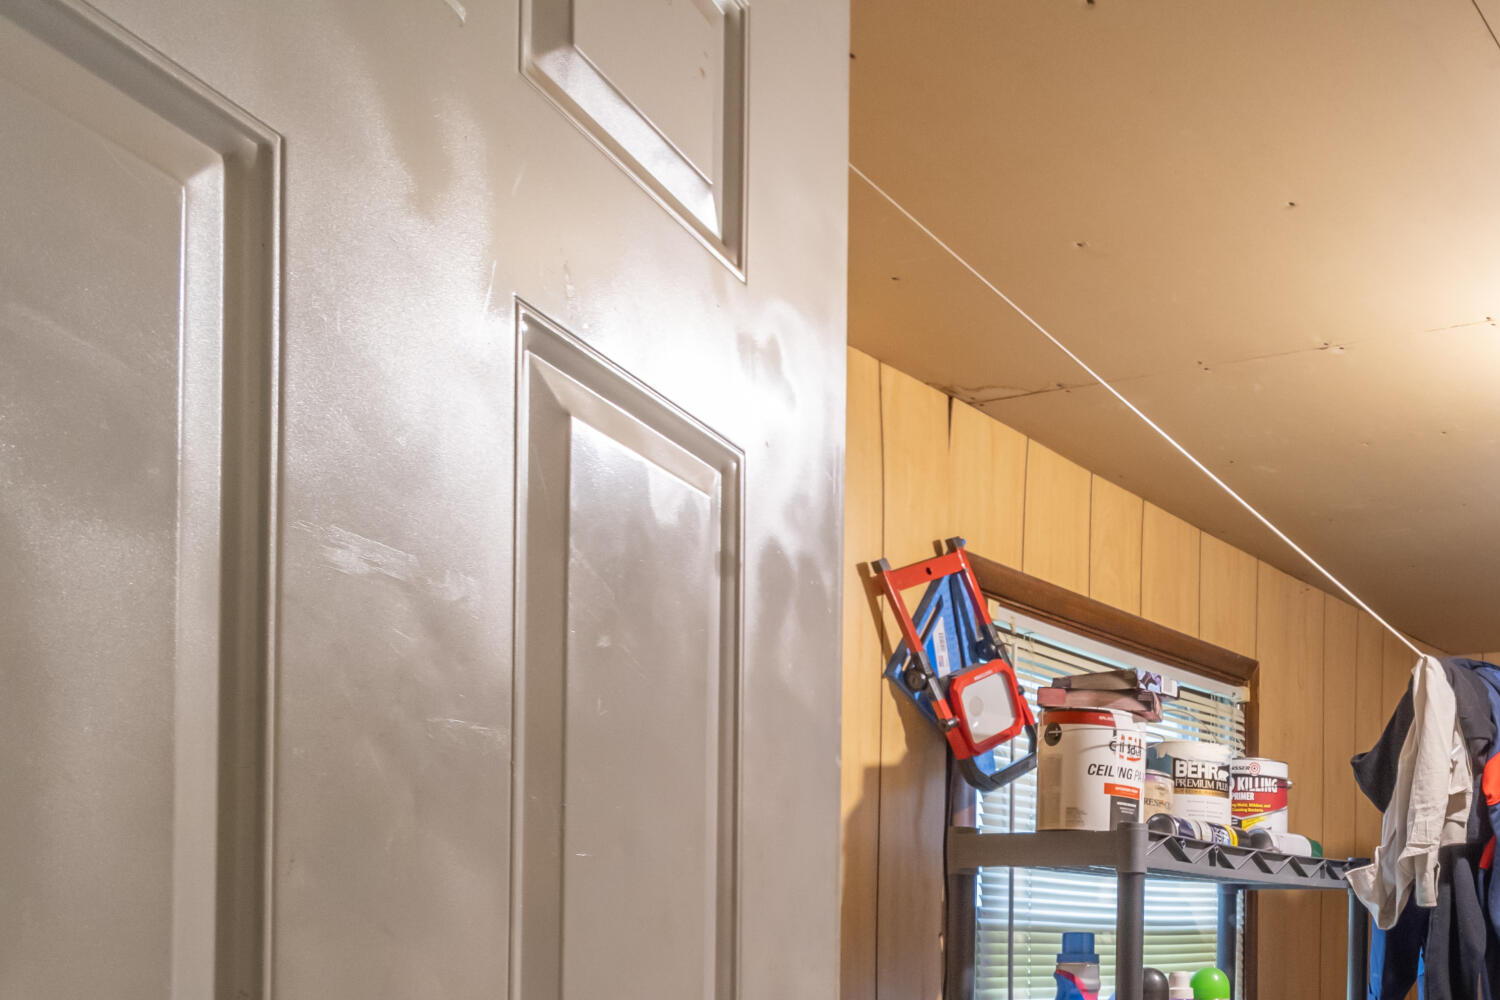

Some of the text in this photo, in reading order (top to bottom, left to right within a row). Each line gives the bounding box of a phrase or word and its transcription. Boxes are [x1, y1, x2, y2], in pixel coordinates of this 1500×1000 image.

[1087, 763, 1133, 780] CEILNG
[1175, 760, 1219, 779] BEHR
[1175, 778, 1215, 790] PREMIUM
[1237, 776, 1278, 793] KILLING
